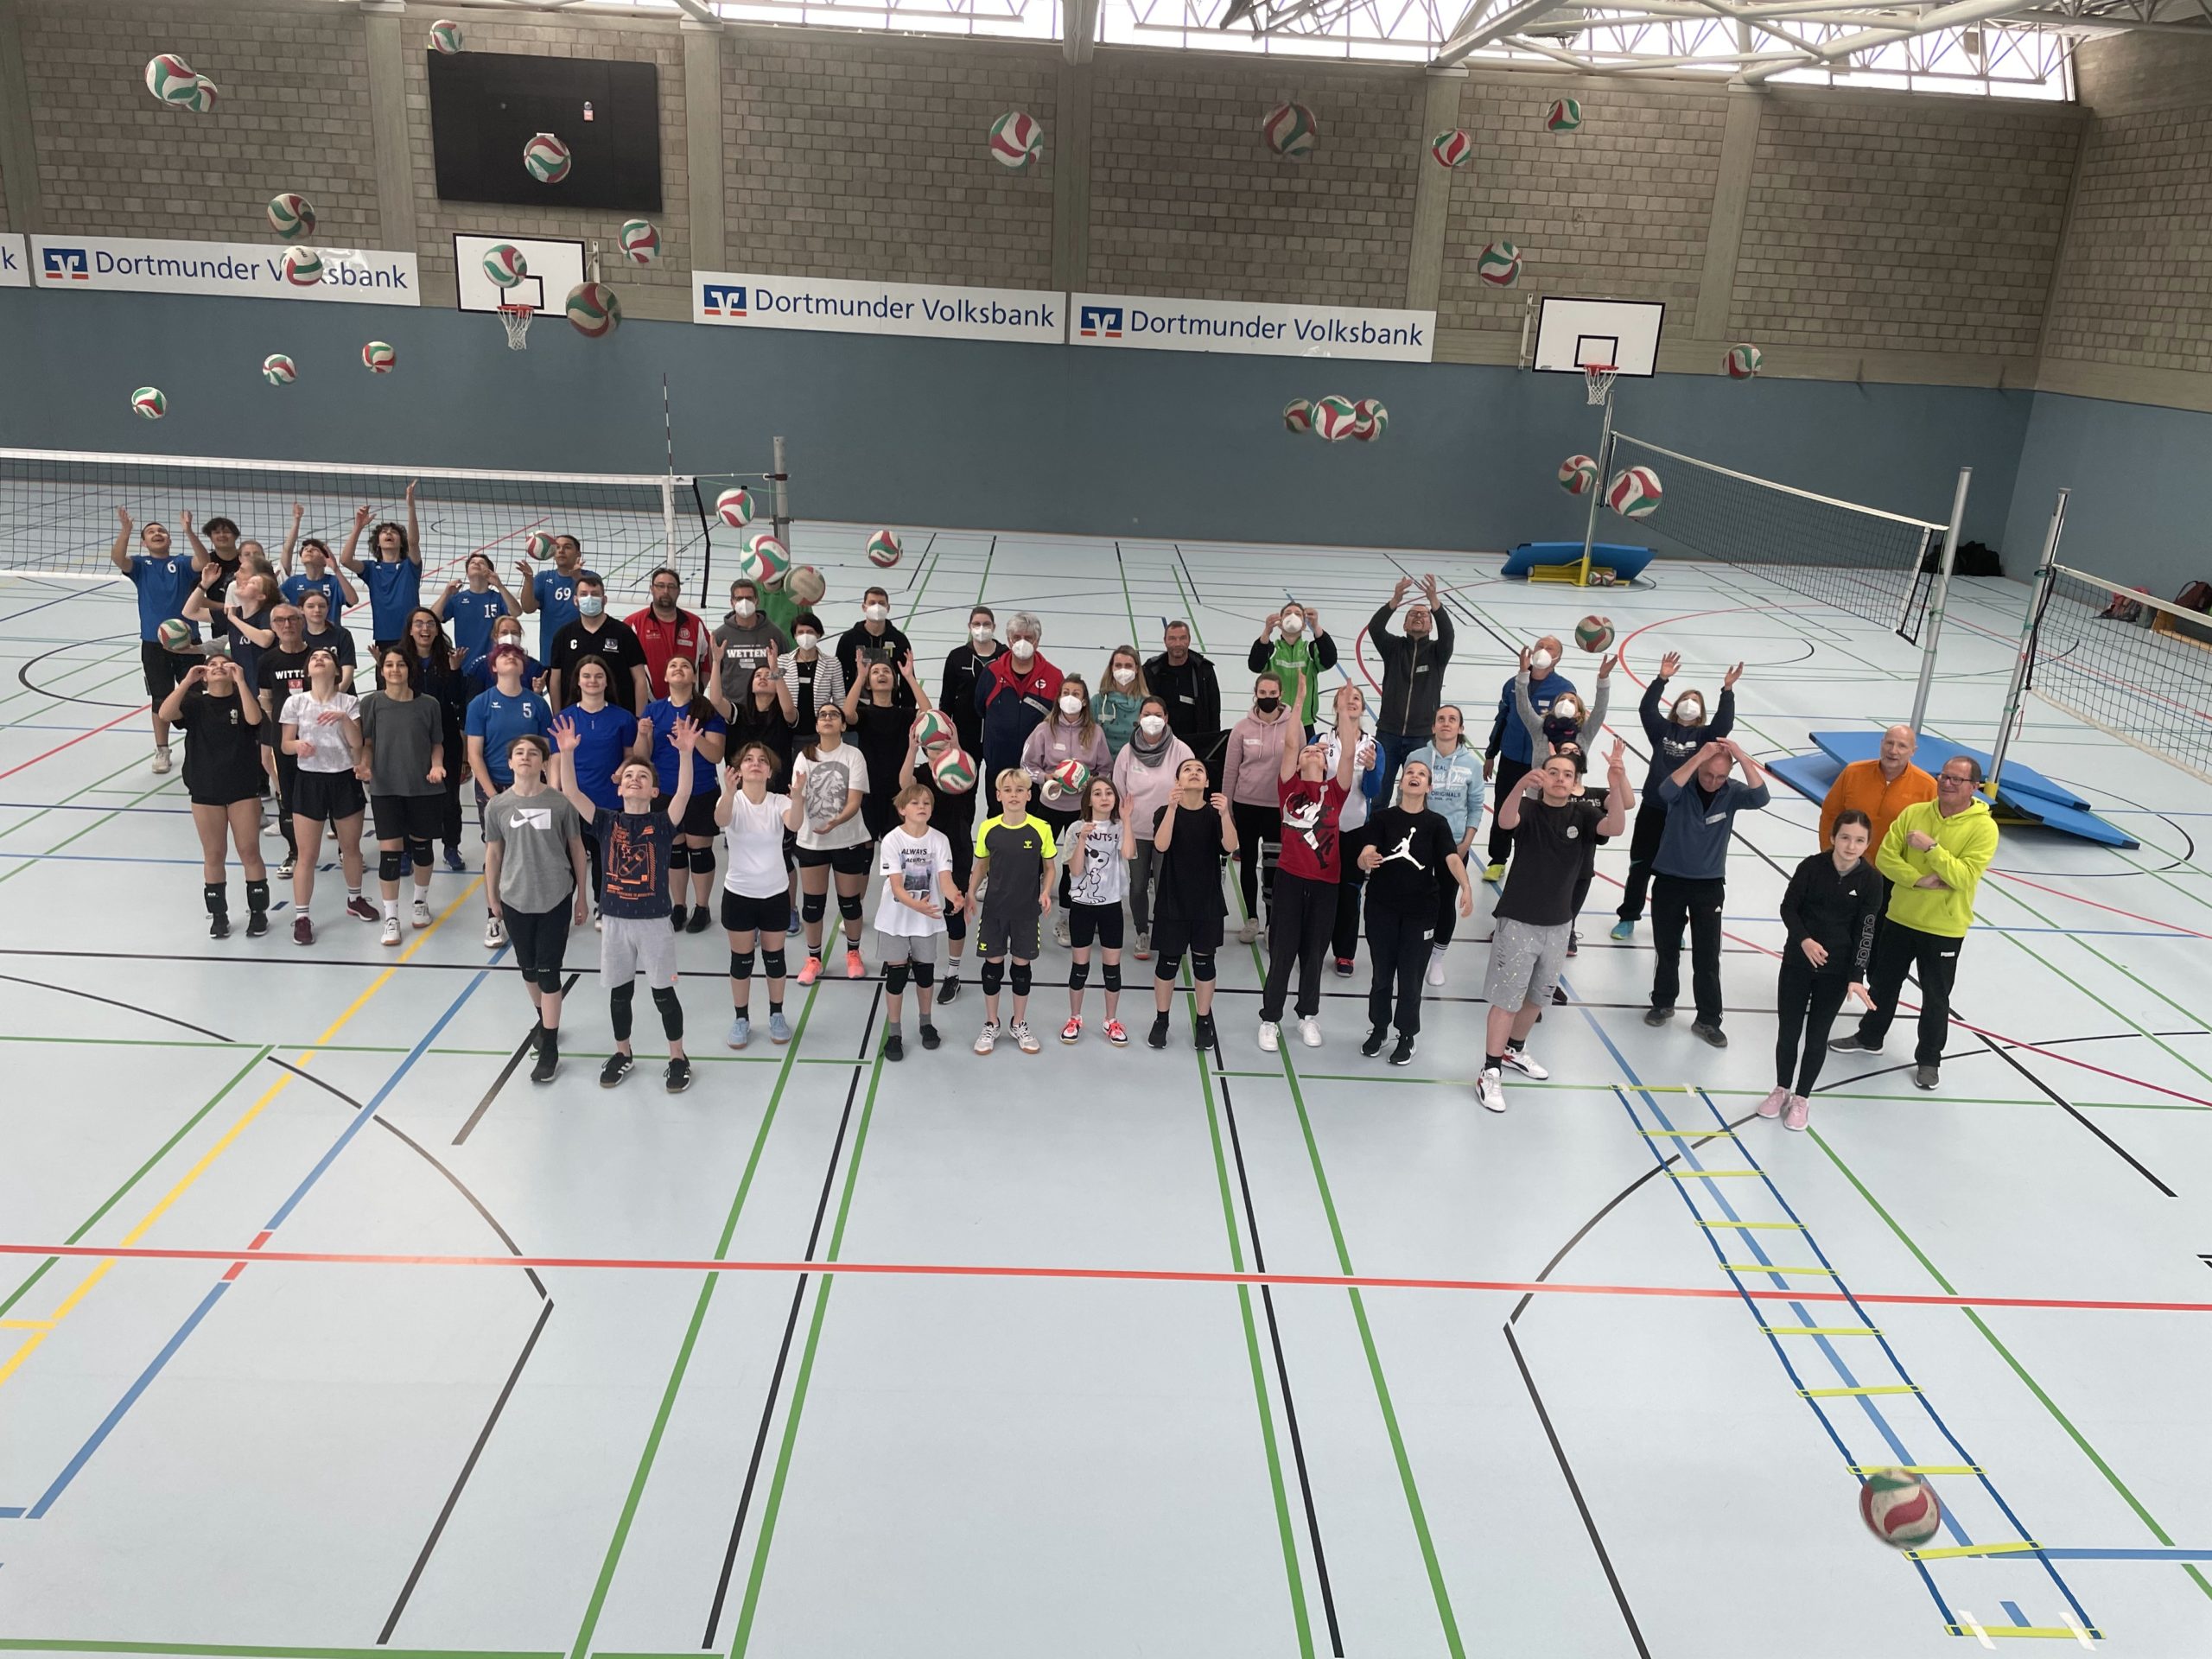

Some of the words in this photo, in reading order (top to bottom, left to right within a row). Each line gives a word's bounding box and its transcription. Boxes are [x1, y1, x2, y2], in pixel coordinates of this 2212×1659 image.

[95, 251, 260, 280] Dortmunder
[267, 259, 408, 289] Vsbank
[756, 289, 914, 319] Dortmunder
[922, 298, 1054, 327] Volksbank
[1131, 310, 1287, 339] Dortmunder
[1294, 319, 1423, 346] Volksbank
[167, 562, 176, 574] 6
[323, 584, 332, 597] 5
[555, 588, 572, 601] 69
[484, 604, 498, 619] 15
[570, 639, 578, 650] C
[727, 649, 767, 658] WETTEN
[523, 702, 532, 718] 5
[1854, 914, 1876, 968] adidas
